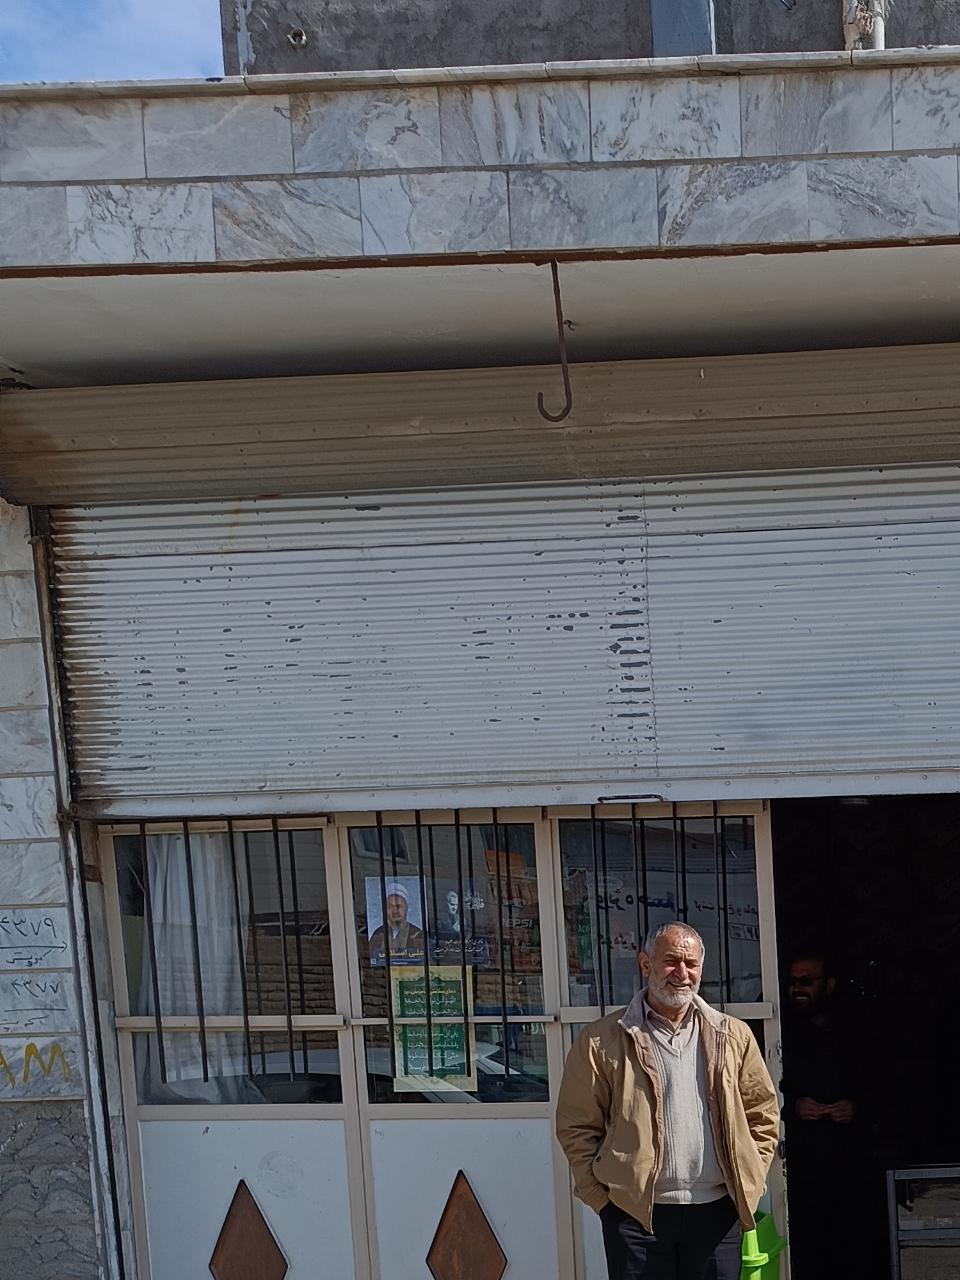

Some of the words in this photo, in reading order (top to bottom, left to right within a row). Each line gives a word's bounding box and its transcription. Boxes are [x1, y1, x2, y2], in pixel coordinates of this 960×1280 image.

[0, 916, 57, 938] ۴۳۷۹
[378, 948, 408, 959] اسلای
[408, 948, 425, 957] علی
[11, 981, 60, 998] ۴۳۷۷
